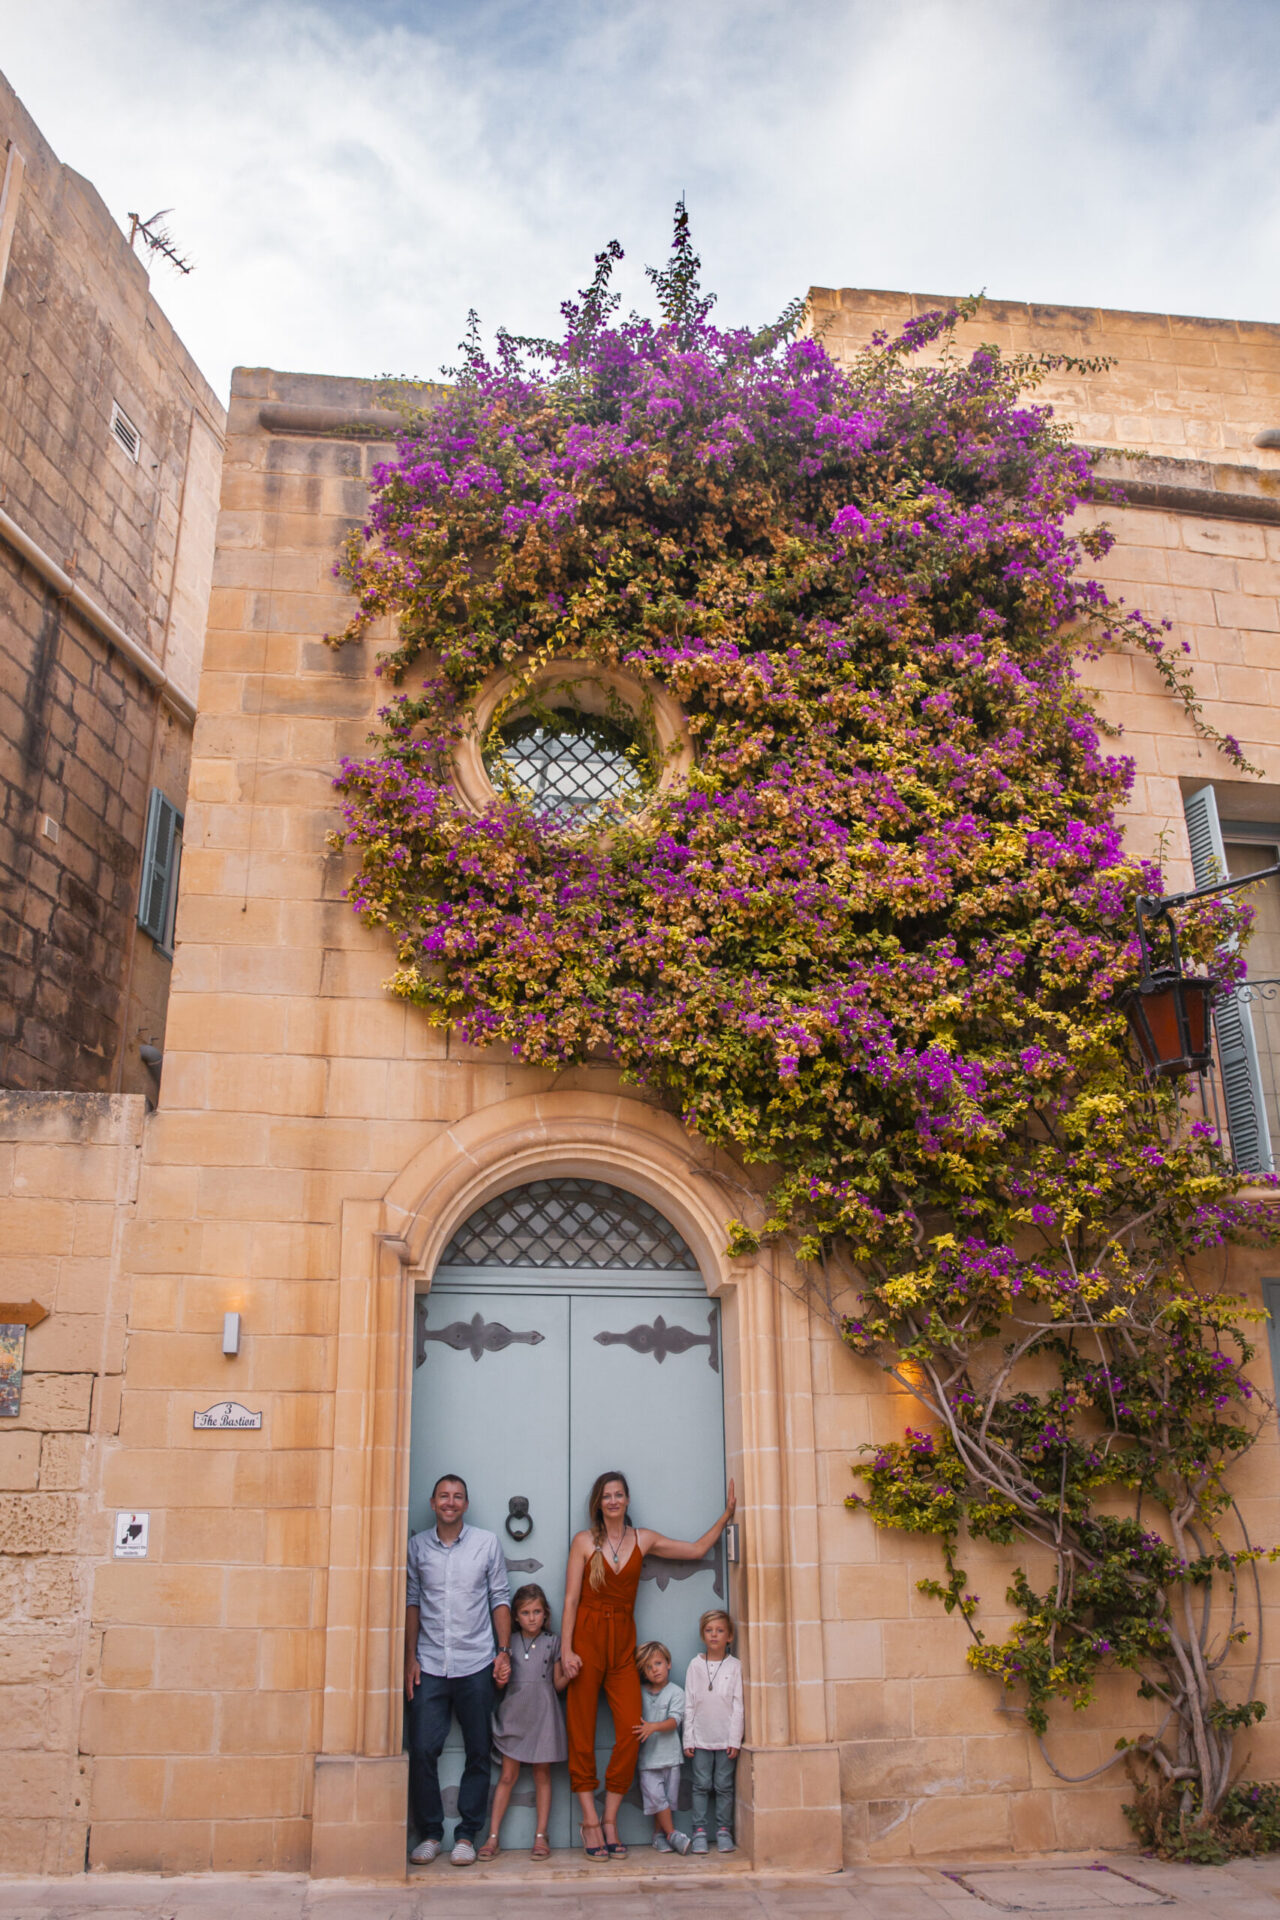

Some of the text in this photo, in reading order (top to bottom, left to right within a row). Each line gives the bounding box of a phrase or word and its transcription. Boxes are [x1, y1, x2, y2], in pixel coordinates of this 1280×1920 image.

[224, 1403, 233, 1415] 3
[199, 1414, 256, 1427] The Bastion
